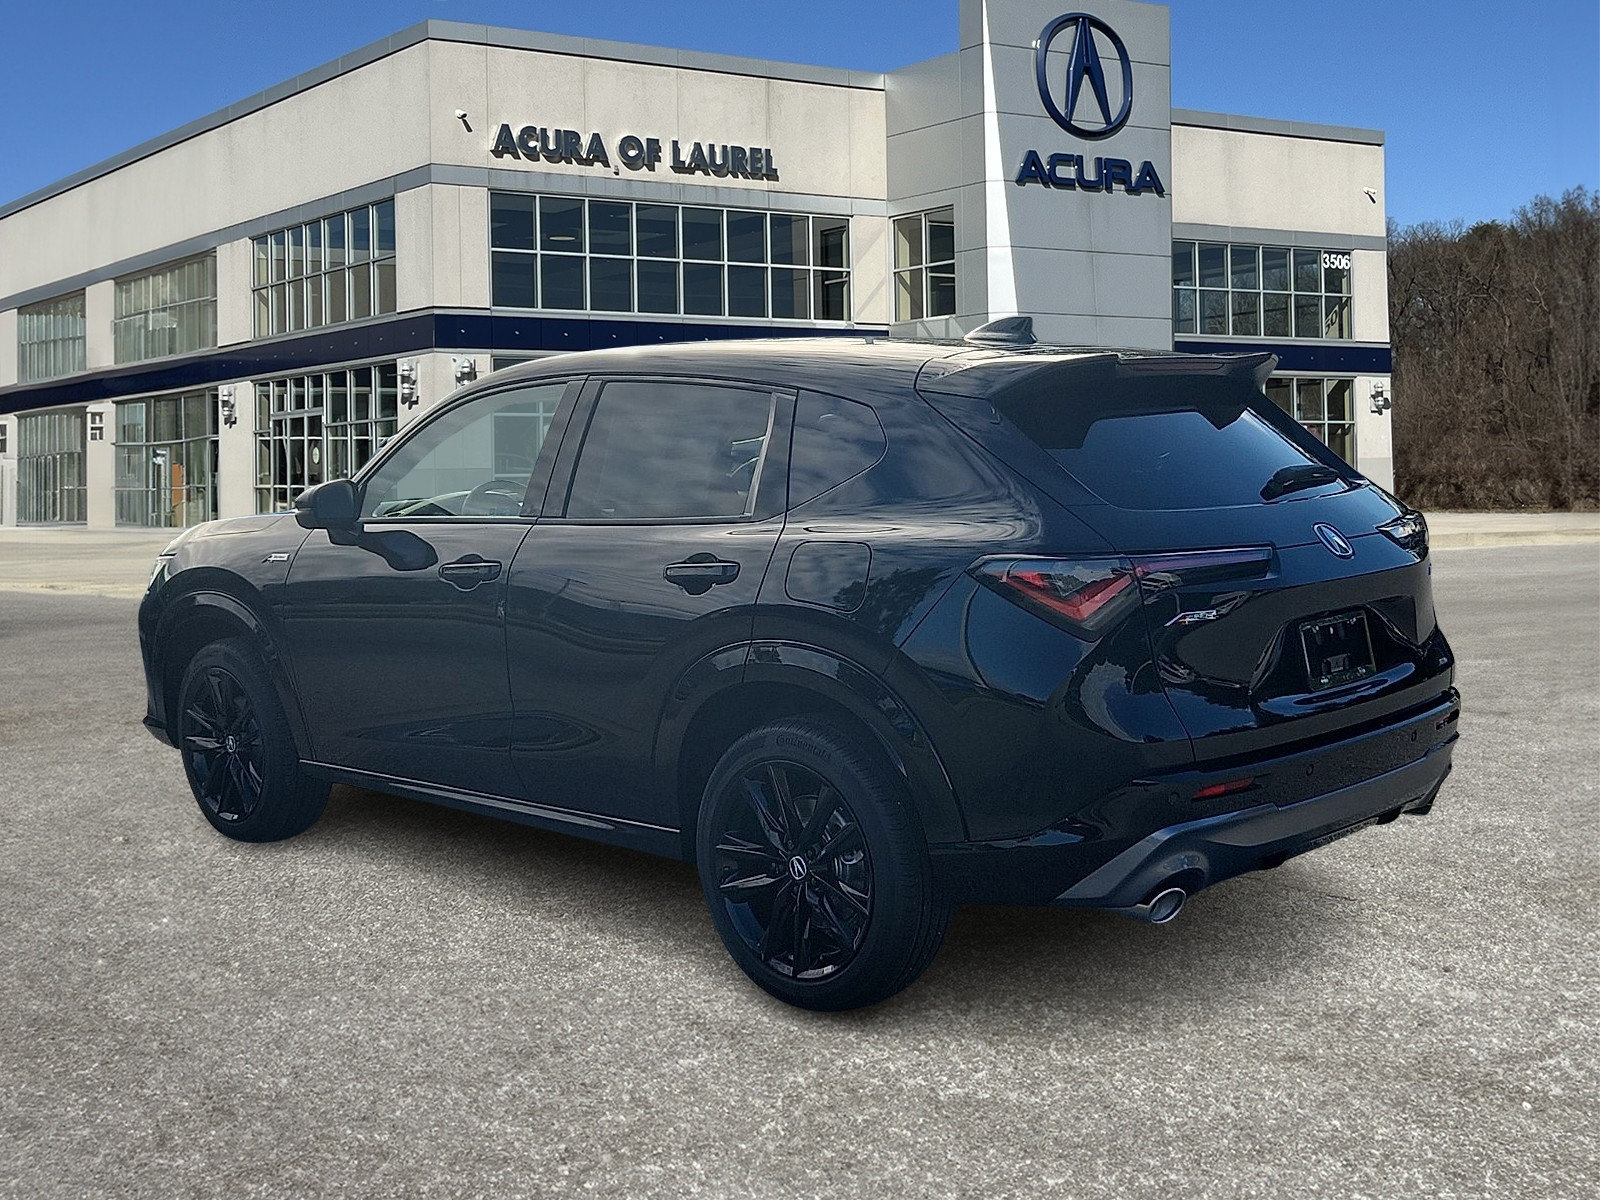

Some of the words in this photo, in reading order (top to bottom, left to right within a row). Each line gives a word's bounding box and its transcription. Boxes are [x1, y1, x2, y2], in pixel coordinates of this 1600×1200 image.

[491, 123, 611, 166] ACURA
[617, 135, 662, 171] OF
[670, 140, 779, 181] LAUREL
[1015, 150, 1166, 197] ACURA
[1322, 253, 1351, 270] 3506
